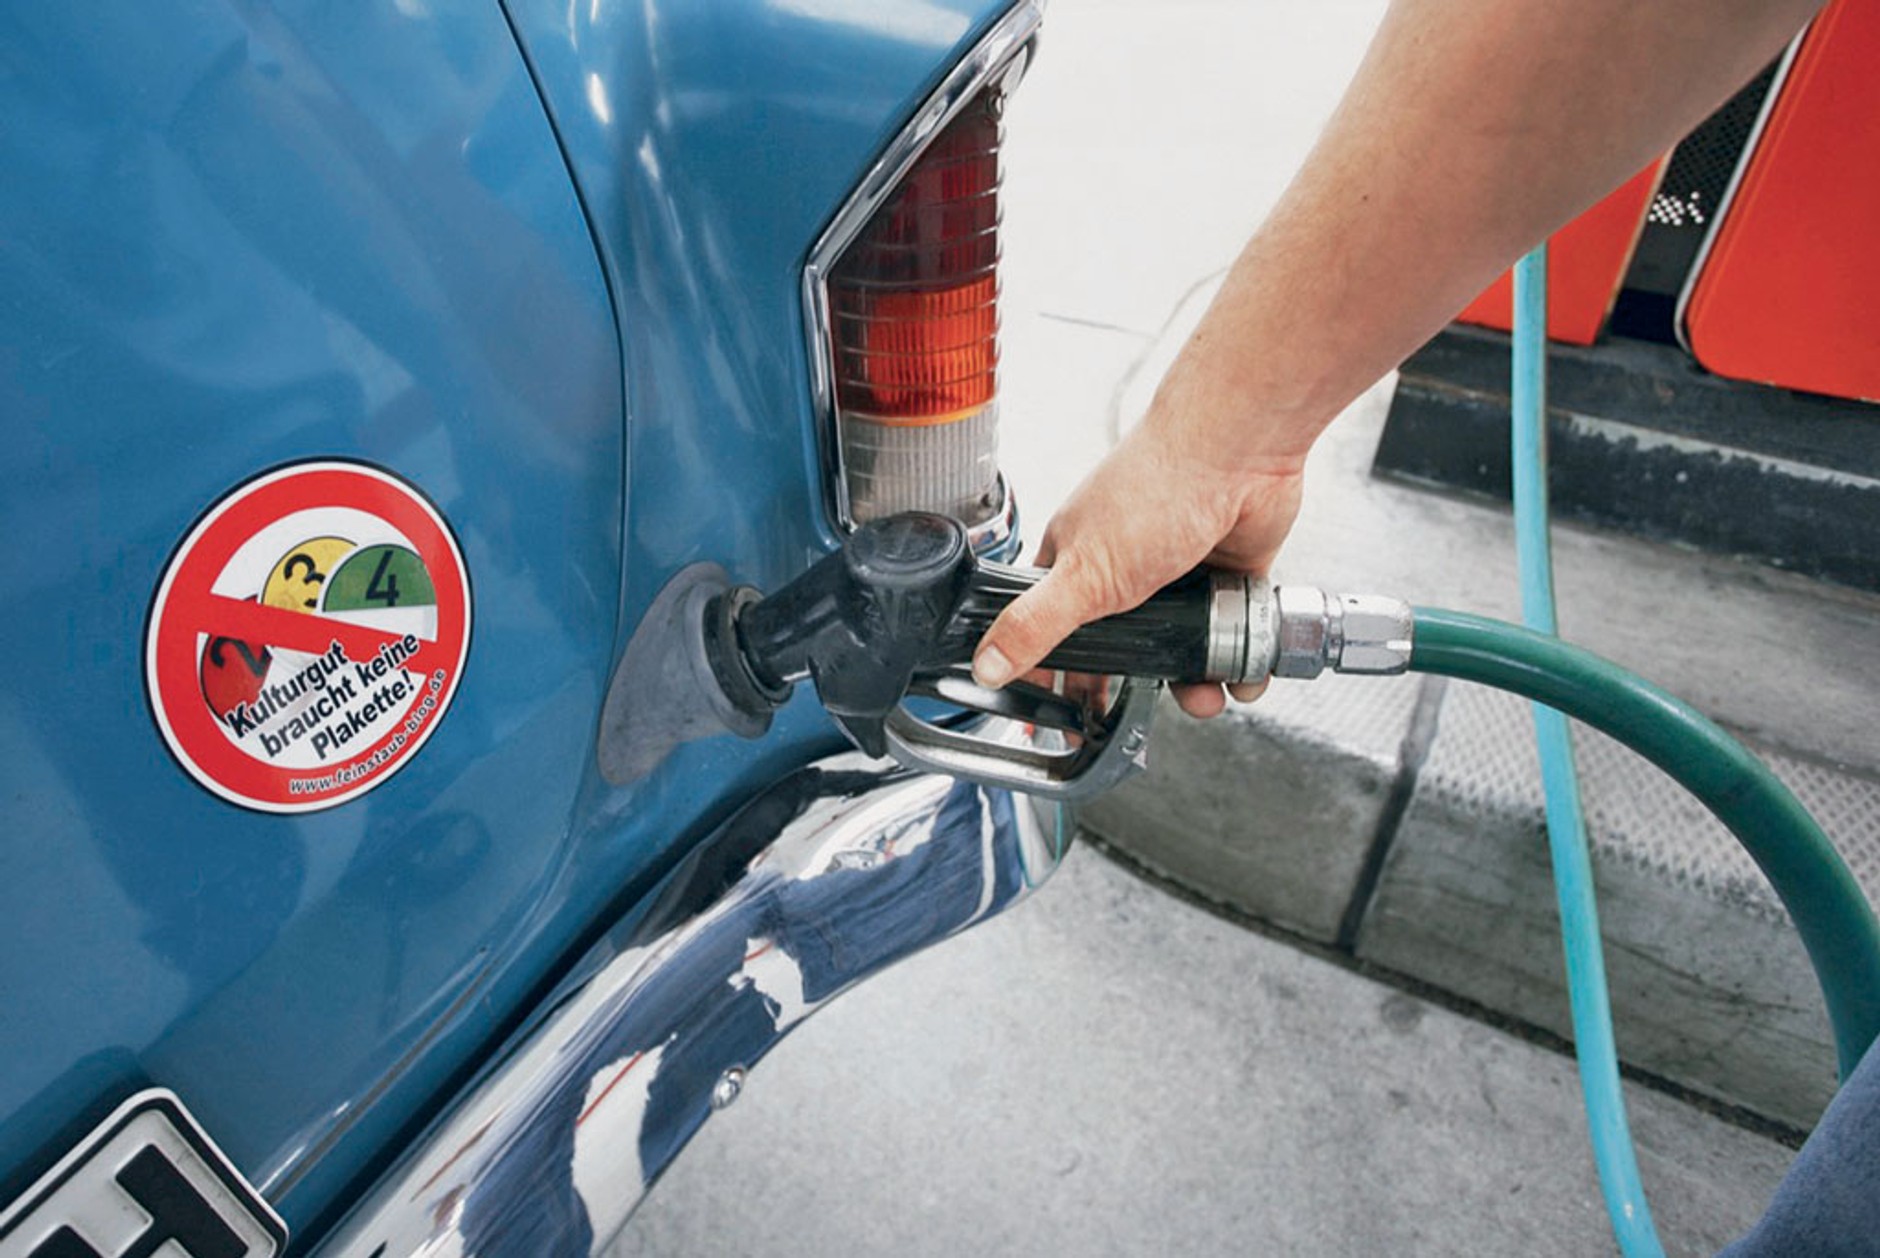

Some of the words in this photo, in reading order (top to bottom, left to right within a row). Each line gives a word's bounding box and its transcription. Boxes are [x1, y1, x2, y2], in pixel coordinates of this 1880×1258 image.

[366, 550, 399, 606] 4
[210, 636, 273, 677] 2
[227, 643, 347, 738] Kulturgut
[259, 676, 356, 758] braucht
[355, 634, 418, 689] keine
[290, 670, 444, 792] www.feinstaub-blog.de
[310, 670, 414, 761] Plakette!
